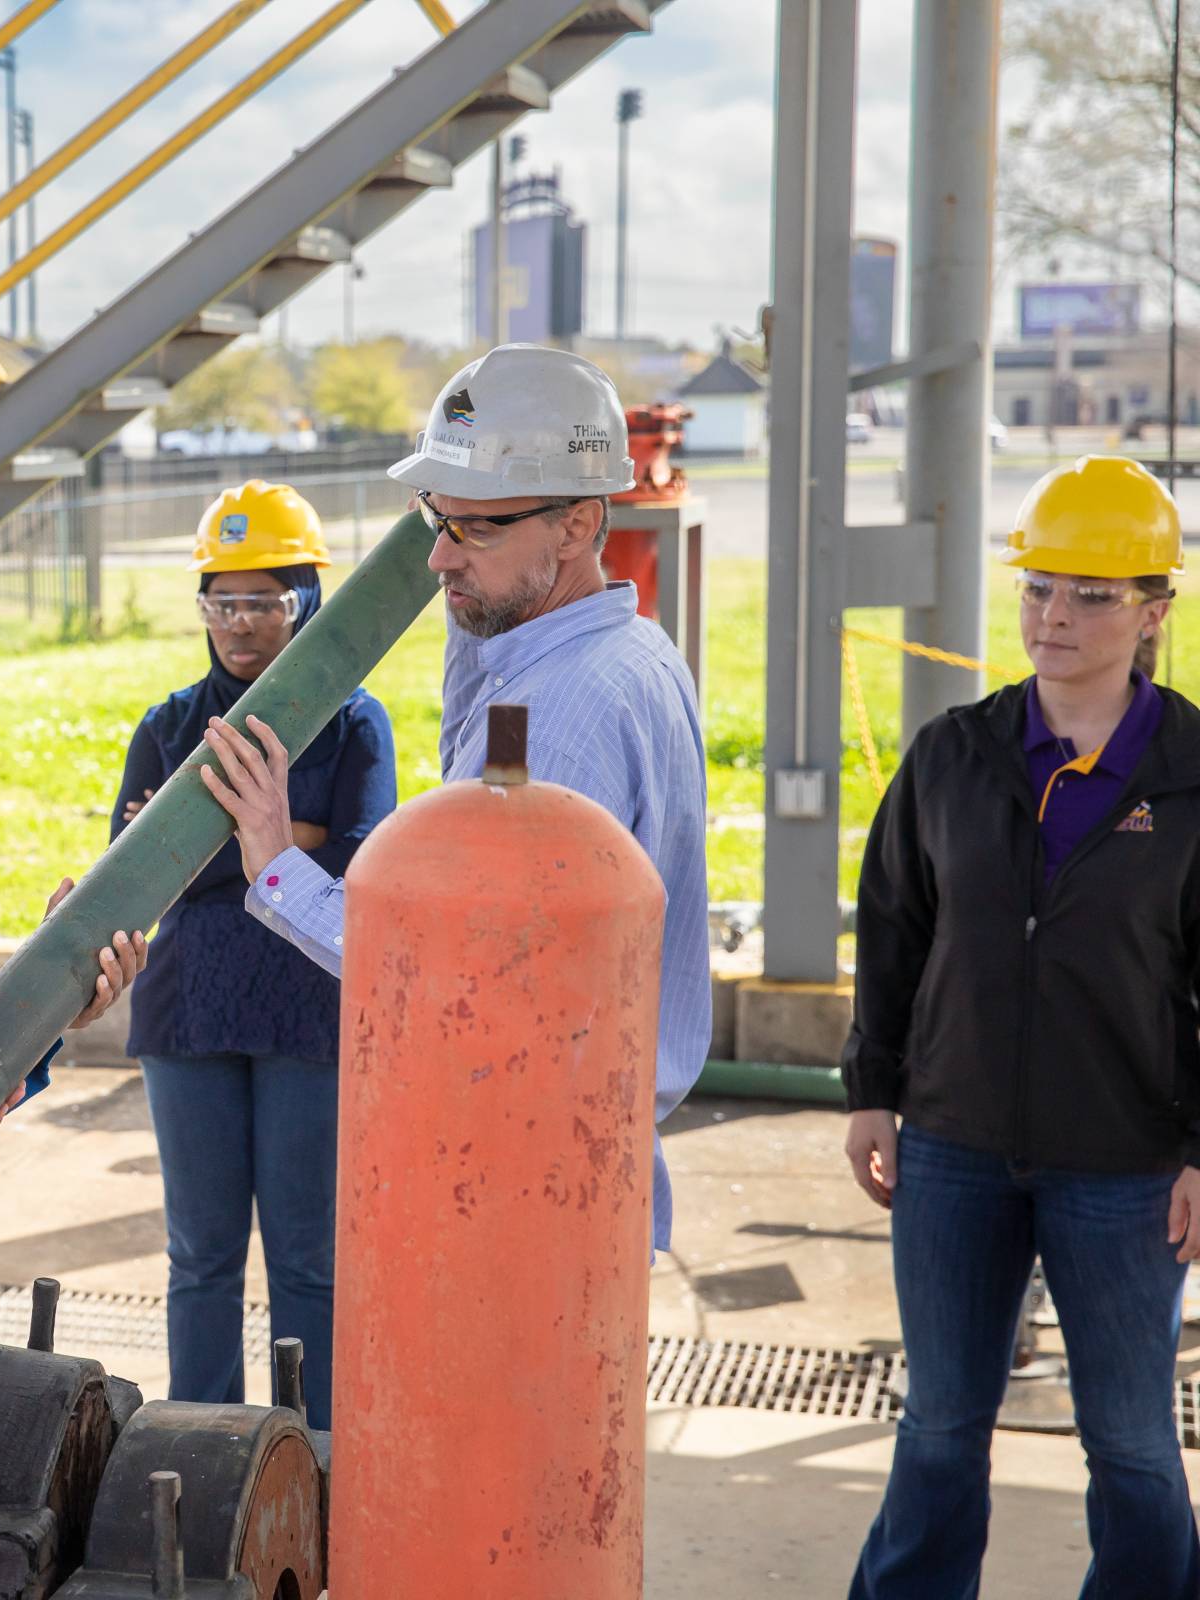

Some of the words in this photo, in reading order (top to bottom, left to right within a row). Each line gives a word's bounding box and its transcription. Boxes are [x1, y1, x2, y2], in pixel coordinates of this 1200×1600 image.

[573, 424, 608, 438] THINK
[433, 431, 476, 449] MOND
[567, 440, 611, 454] SAFETY
